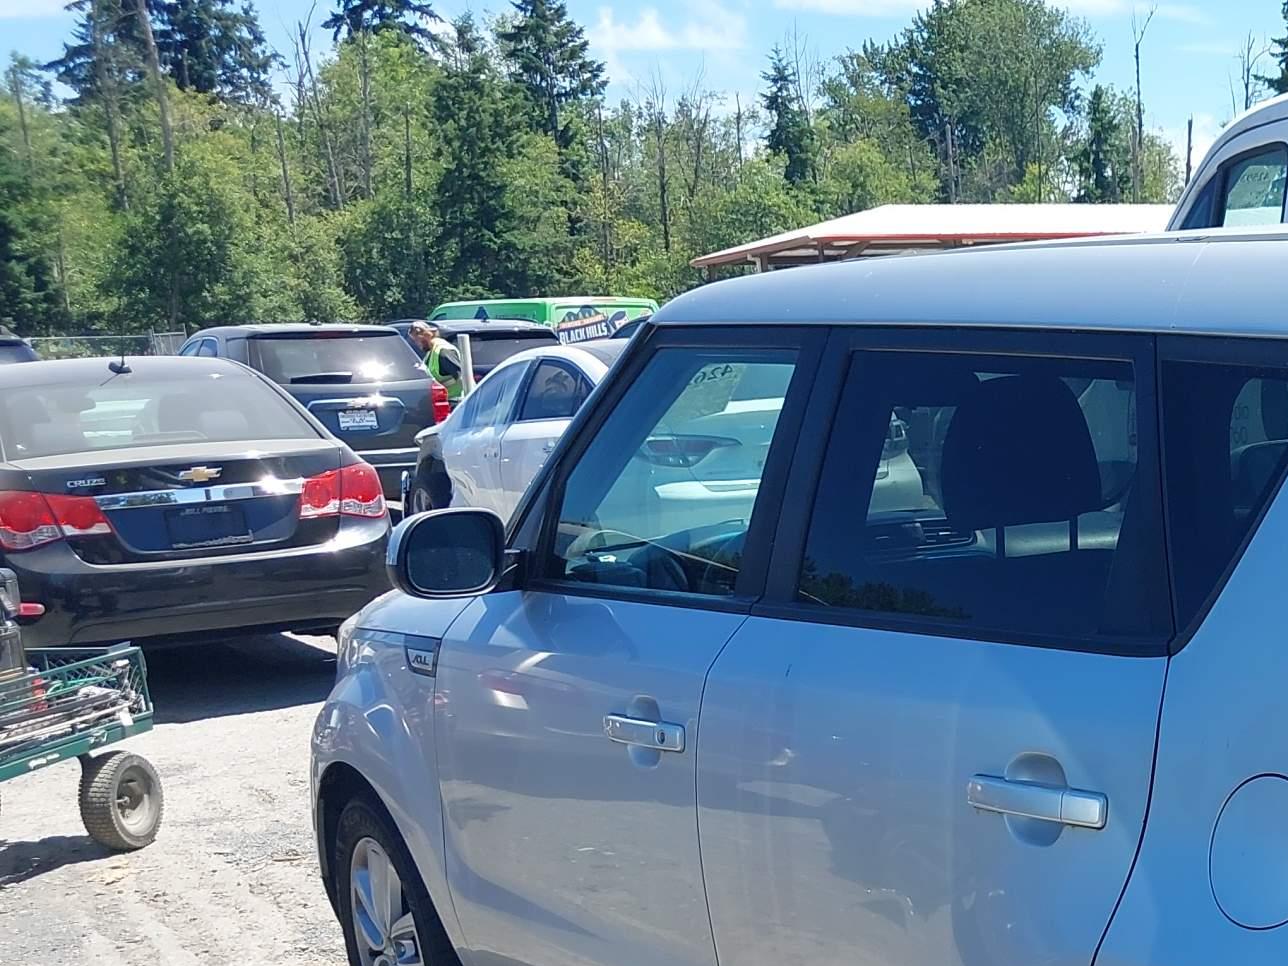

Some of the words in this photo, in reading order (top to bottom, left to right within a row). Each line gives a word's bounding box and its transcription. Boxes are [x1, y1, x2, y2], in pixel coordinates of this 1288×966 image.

[559, 327, 586, 345] BLACK
[586, 322, 608, 339] HILLS
[66, 477, 106, 488] CRUZE
